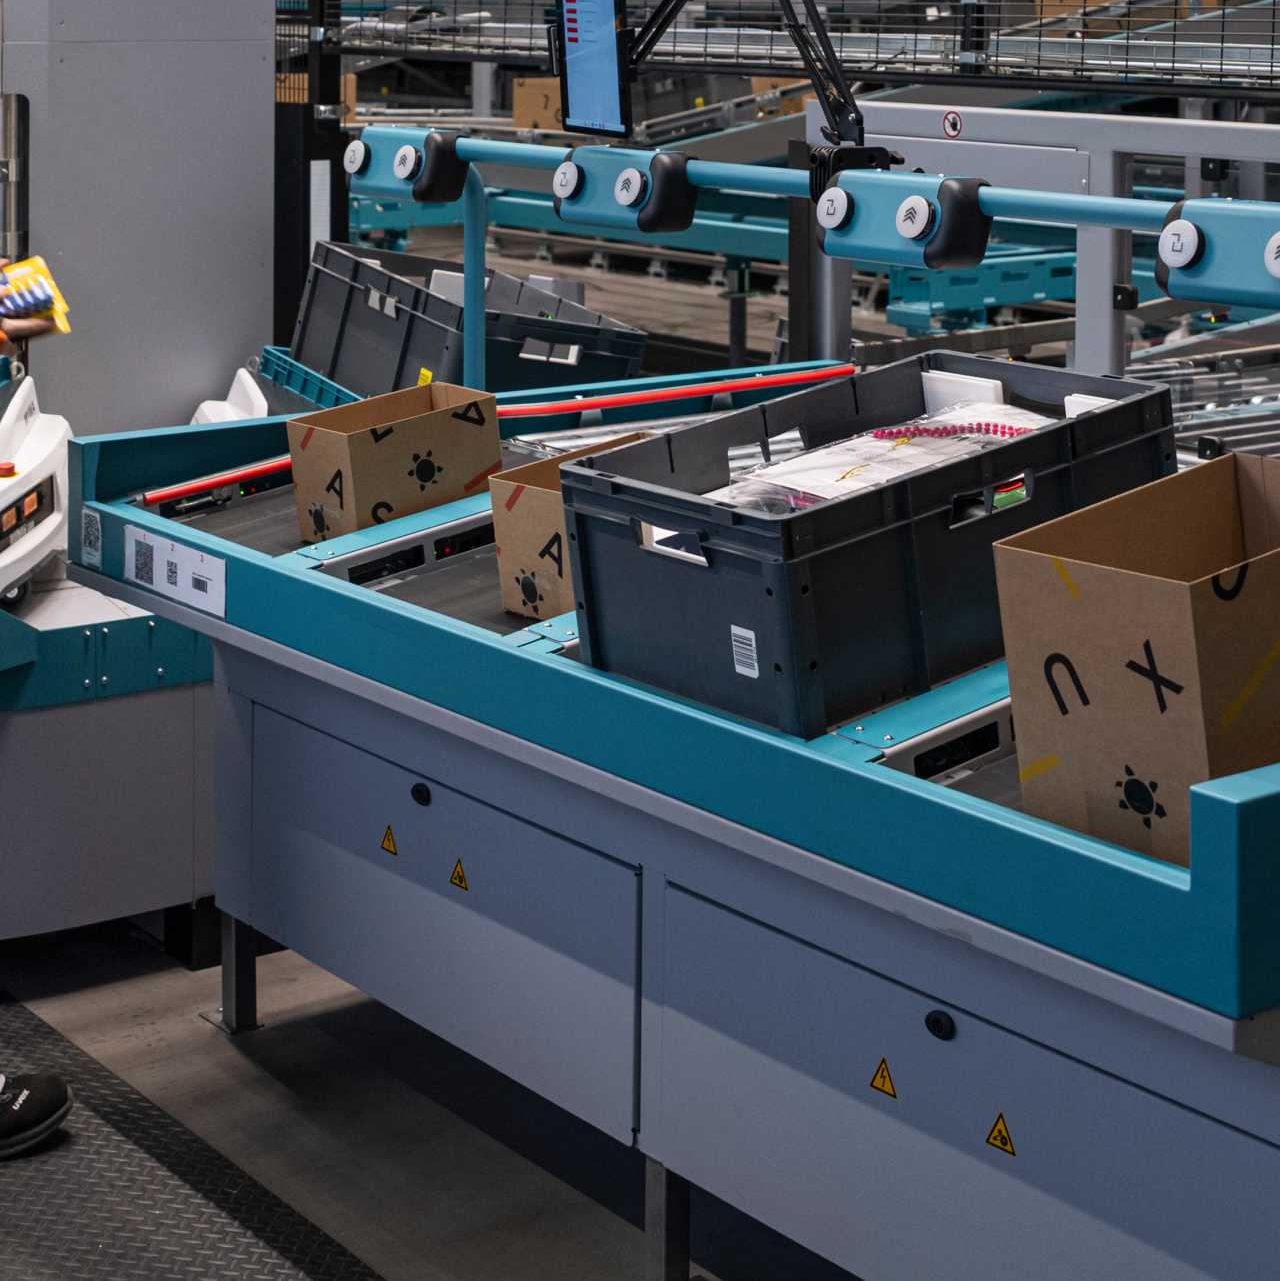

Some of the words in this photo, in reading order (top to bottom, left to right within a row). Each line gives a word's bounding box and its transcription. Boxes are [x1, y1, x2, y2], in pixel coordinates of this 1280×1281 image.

[325, 468, 344, 511] A
[538, 531, 564, 579] A
[1125, 638, 1185, 715] X
[11, 1088, 31, 1111] uvex
